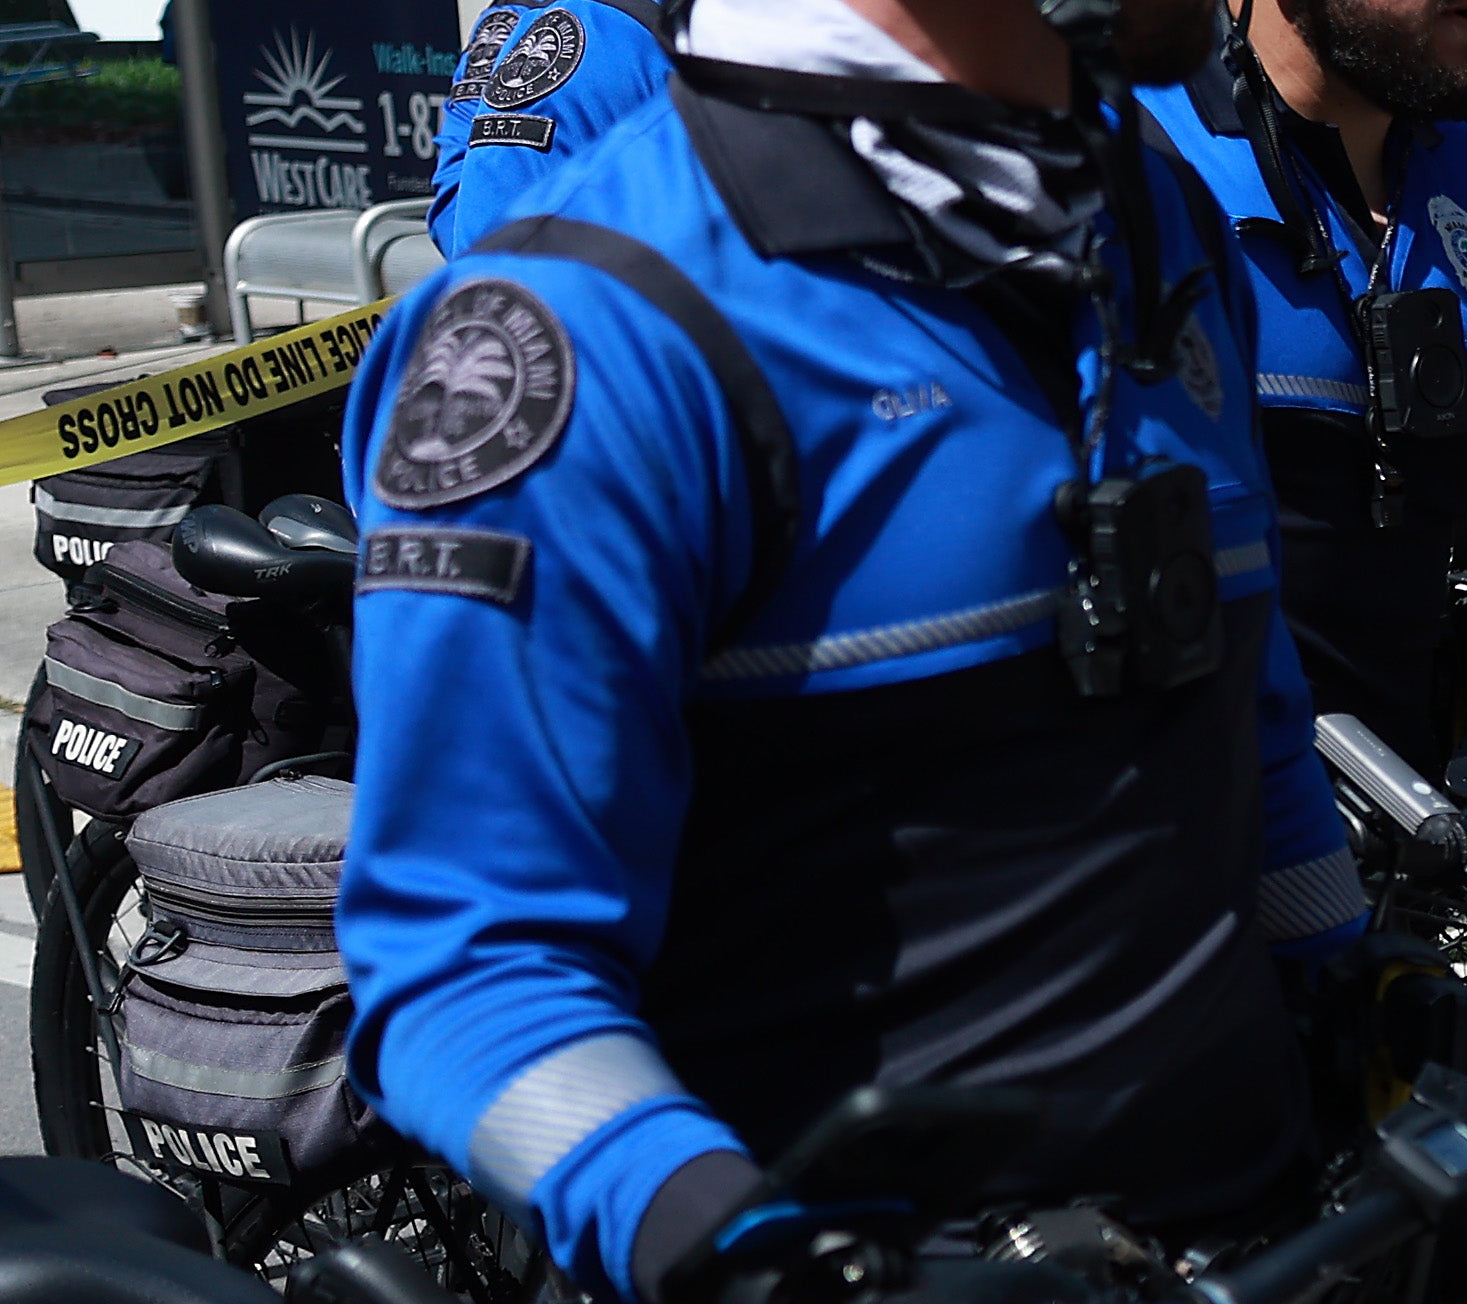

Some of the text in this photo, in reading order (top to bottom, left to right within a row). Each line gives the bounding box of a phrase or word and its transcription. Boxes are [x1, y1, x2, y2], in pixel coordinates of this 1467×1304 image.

[481, 119, 522, 137] B.R.T.
[263, 331, 328, 393] LINE
[503, 303, 558, 400] MIAMI
[163, 370, 225, 428] NOT
[223, 357, 269, 407] DO
[57, 390, 160, 460] CROSS
[390, 453, 482, 493] POLICE
[253, 563, 292, 581] TRK
[51, 718, 128, 774] POLICE
[143, 1116, 268, 1183] POLICE
